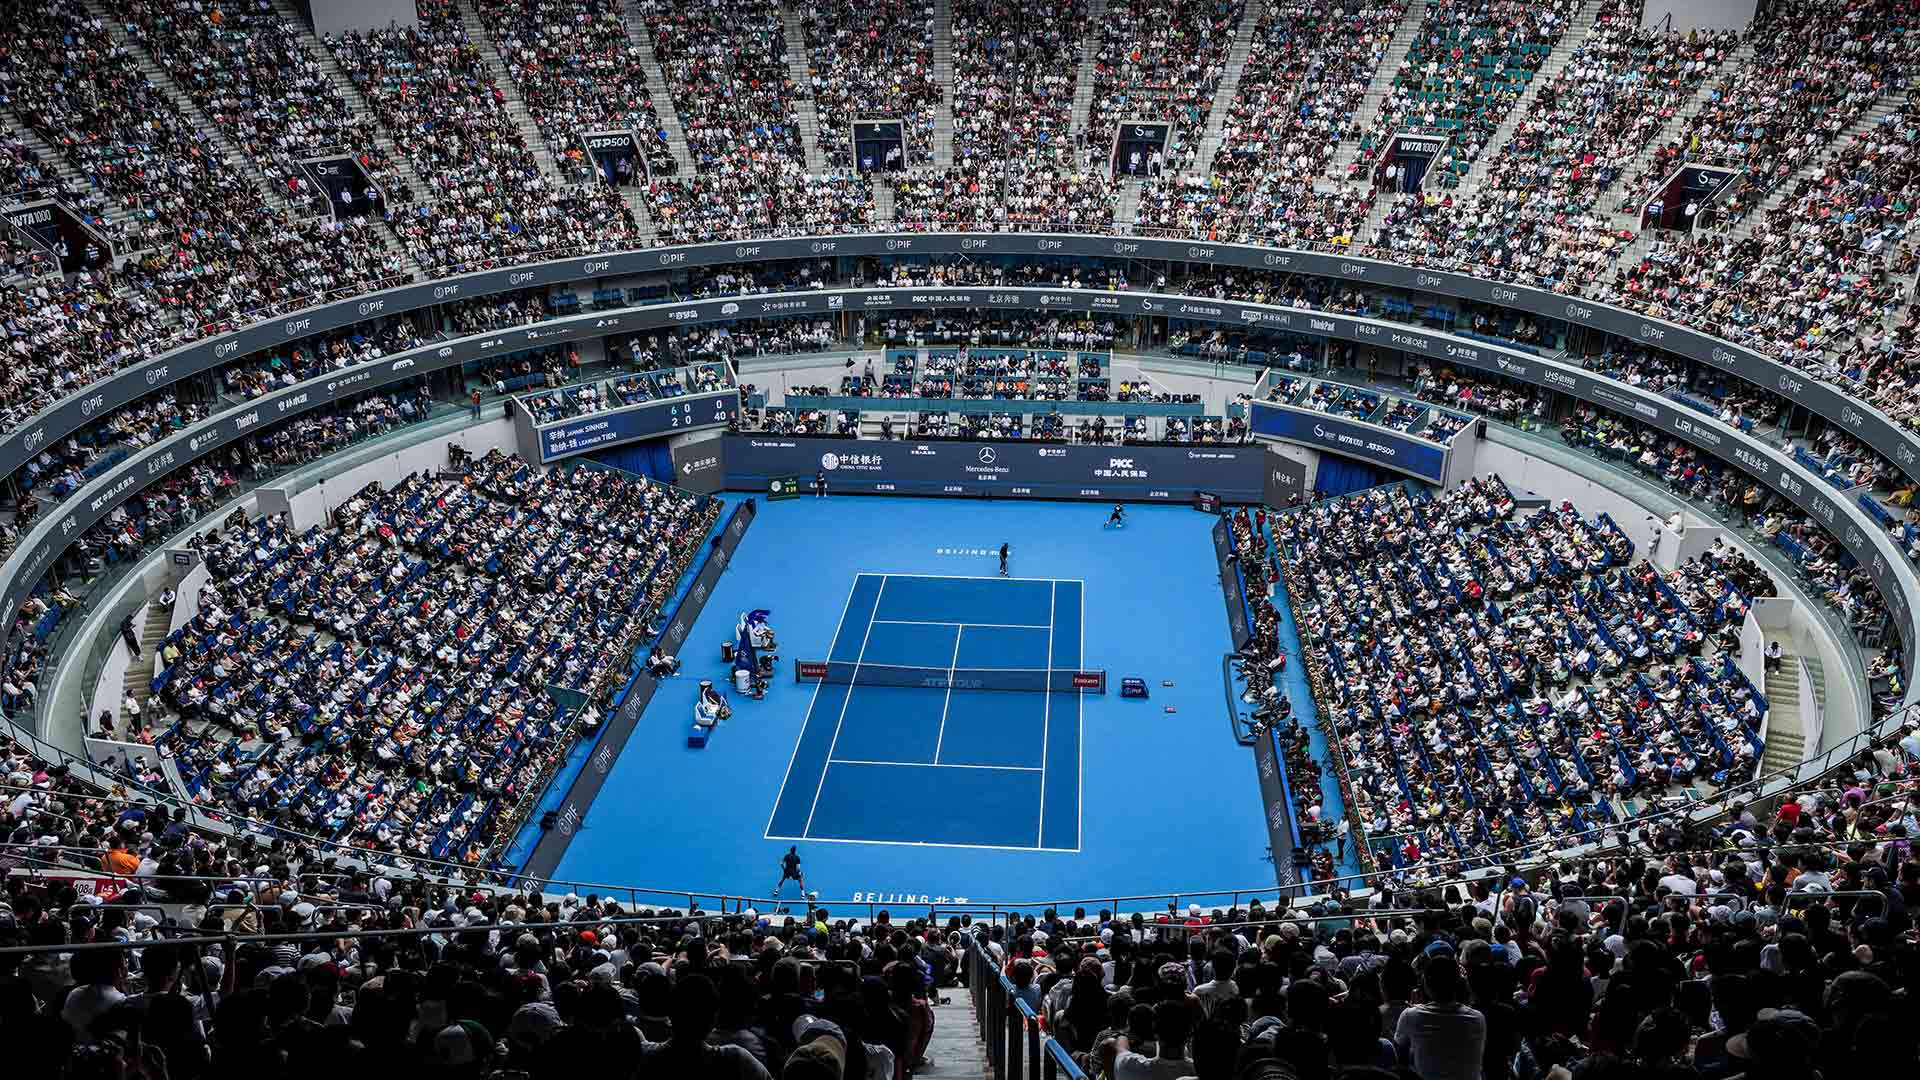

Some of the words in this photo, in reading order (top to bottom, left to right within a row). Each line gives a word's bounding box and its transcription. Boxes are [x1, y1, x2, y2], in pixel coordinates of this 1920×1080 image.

[590, 137, 630, 148] ATP500
[1401, 140, 1438, 153] WTA1000
[822, 242, 836, 251] PIF
[897, 240, 911, 248] PIF
[973, 240, 987, 248] PIF
[1048, 241, 1062, 249] PIF
[1124, 244, 1139, 252] PIF
[745, 247, 760, 256] PIF
[1199, 249, 1214, 257] PIF
[671, 253, 685, 263] PIF
[1275, 256, 1290, 264] PIF
[595, 261, 609, 271] PIF
[1351, 265, 1366, 275] PIF
[520, 272, 534, 282] PIF
[1427, 276, 1442, 287] PIF
[444, 285, 458, 296] PIF
[1503, 290, 1517, 300] PIF
[370, 300, 384, 312] PIF
[1577, 307, 1592, 318] PIF
[295, 318, 310, 331] PIF
[1650, 328, 1665, 339] PIF
[225, 340, 238, 352] PIF
[1721, 352, 1736, 365] PIF
[154, 366, 168, 380] PIF
[1788, 377, 1802, 393] PIF
[90, 394, 104, 410] PIF
[584, 422, 609, 433] SINNER
[671, 406, 677, 415] 6
[684, 404, 690, 413] 0
[716, 400, 722, 409] 0
[672, 417, 678, 427] 2
[685, 415, 691, 424] 0
[714, 411, 726, 421] 40
[1849, 410, 1864, 427] PIF
[32, 429, 44, 443] PIF
[839, 453, 882, 465] 中信银行
[1903, 446, 1915, 464] PIF
[1110, 458, 1133, 468] PICC
[965, 465, 1009, 473] Mercedes-Benz
[1094, 469, 1148, 478] 中国人民保险
[937, 548, 987, 557] BEIJING
[630, 693, 641, 712] PIF
[599, 744, 612, 765] PIF
[564, 804, 577, 825] PIF
[853, 891, 929, 904] BEIJING
[936, 896, 969, 905] 北京
